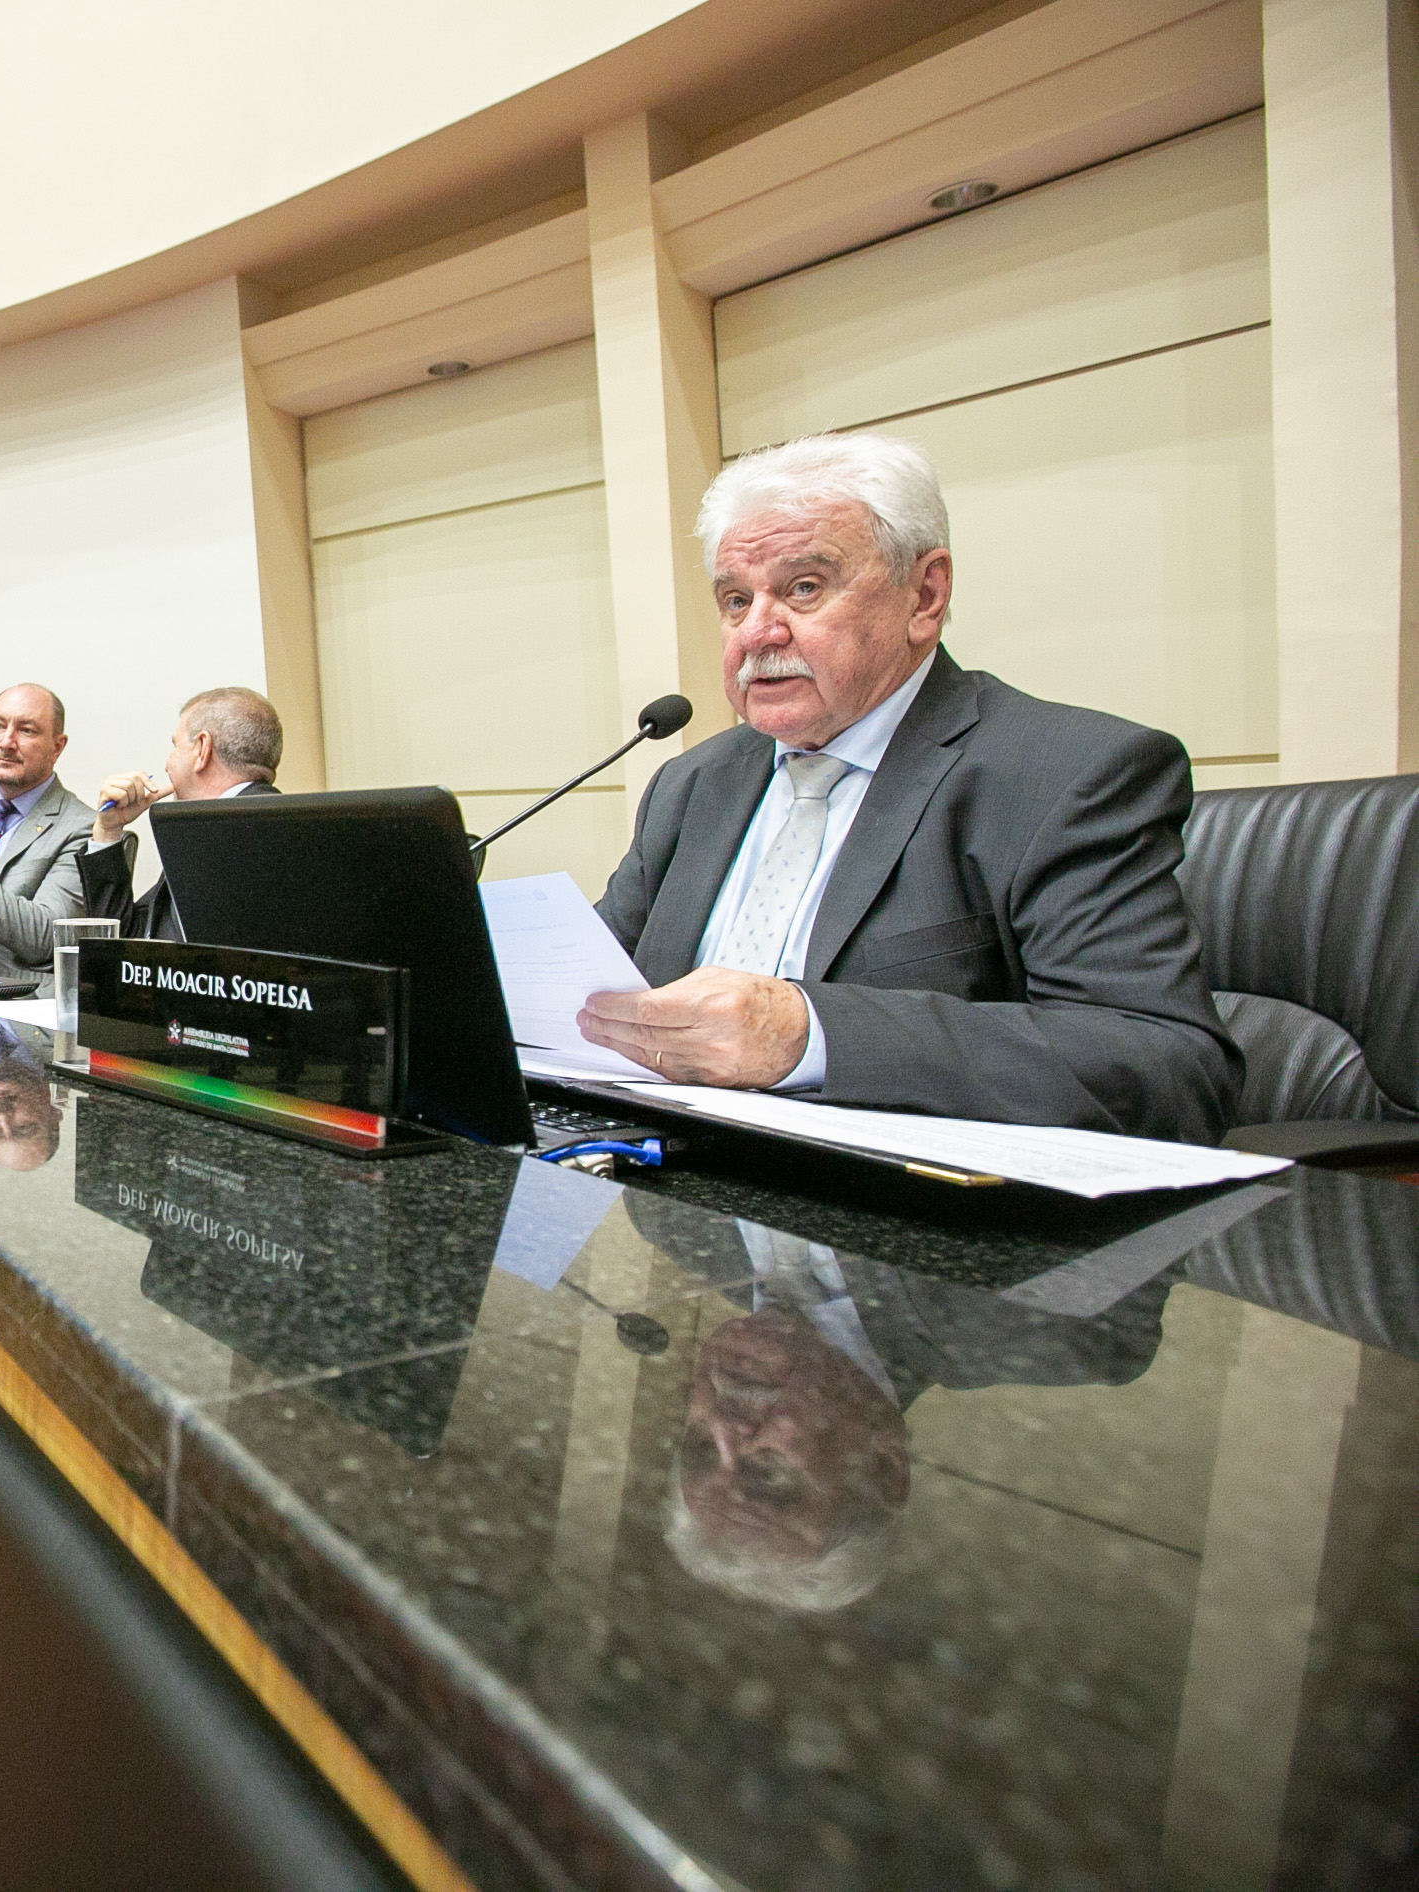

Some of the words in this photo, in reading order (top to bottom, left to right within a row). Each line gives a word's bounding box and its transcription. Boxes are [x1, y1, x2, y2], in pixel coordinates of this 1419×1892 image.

[121, 960, 153, 987] DEP.
[157, 965, 227, 999] MOACIR
[231, 974, 313, 1012] SOPELSA
